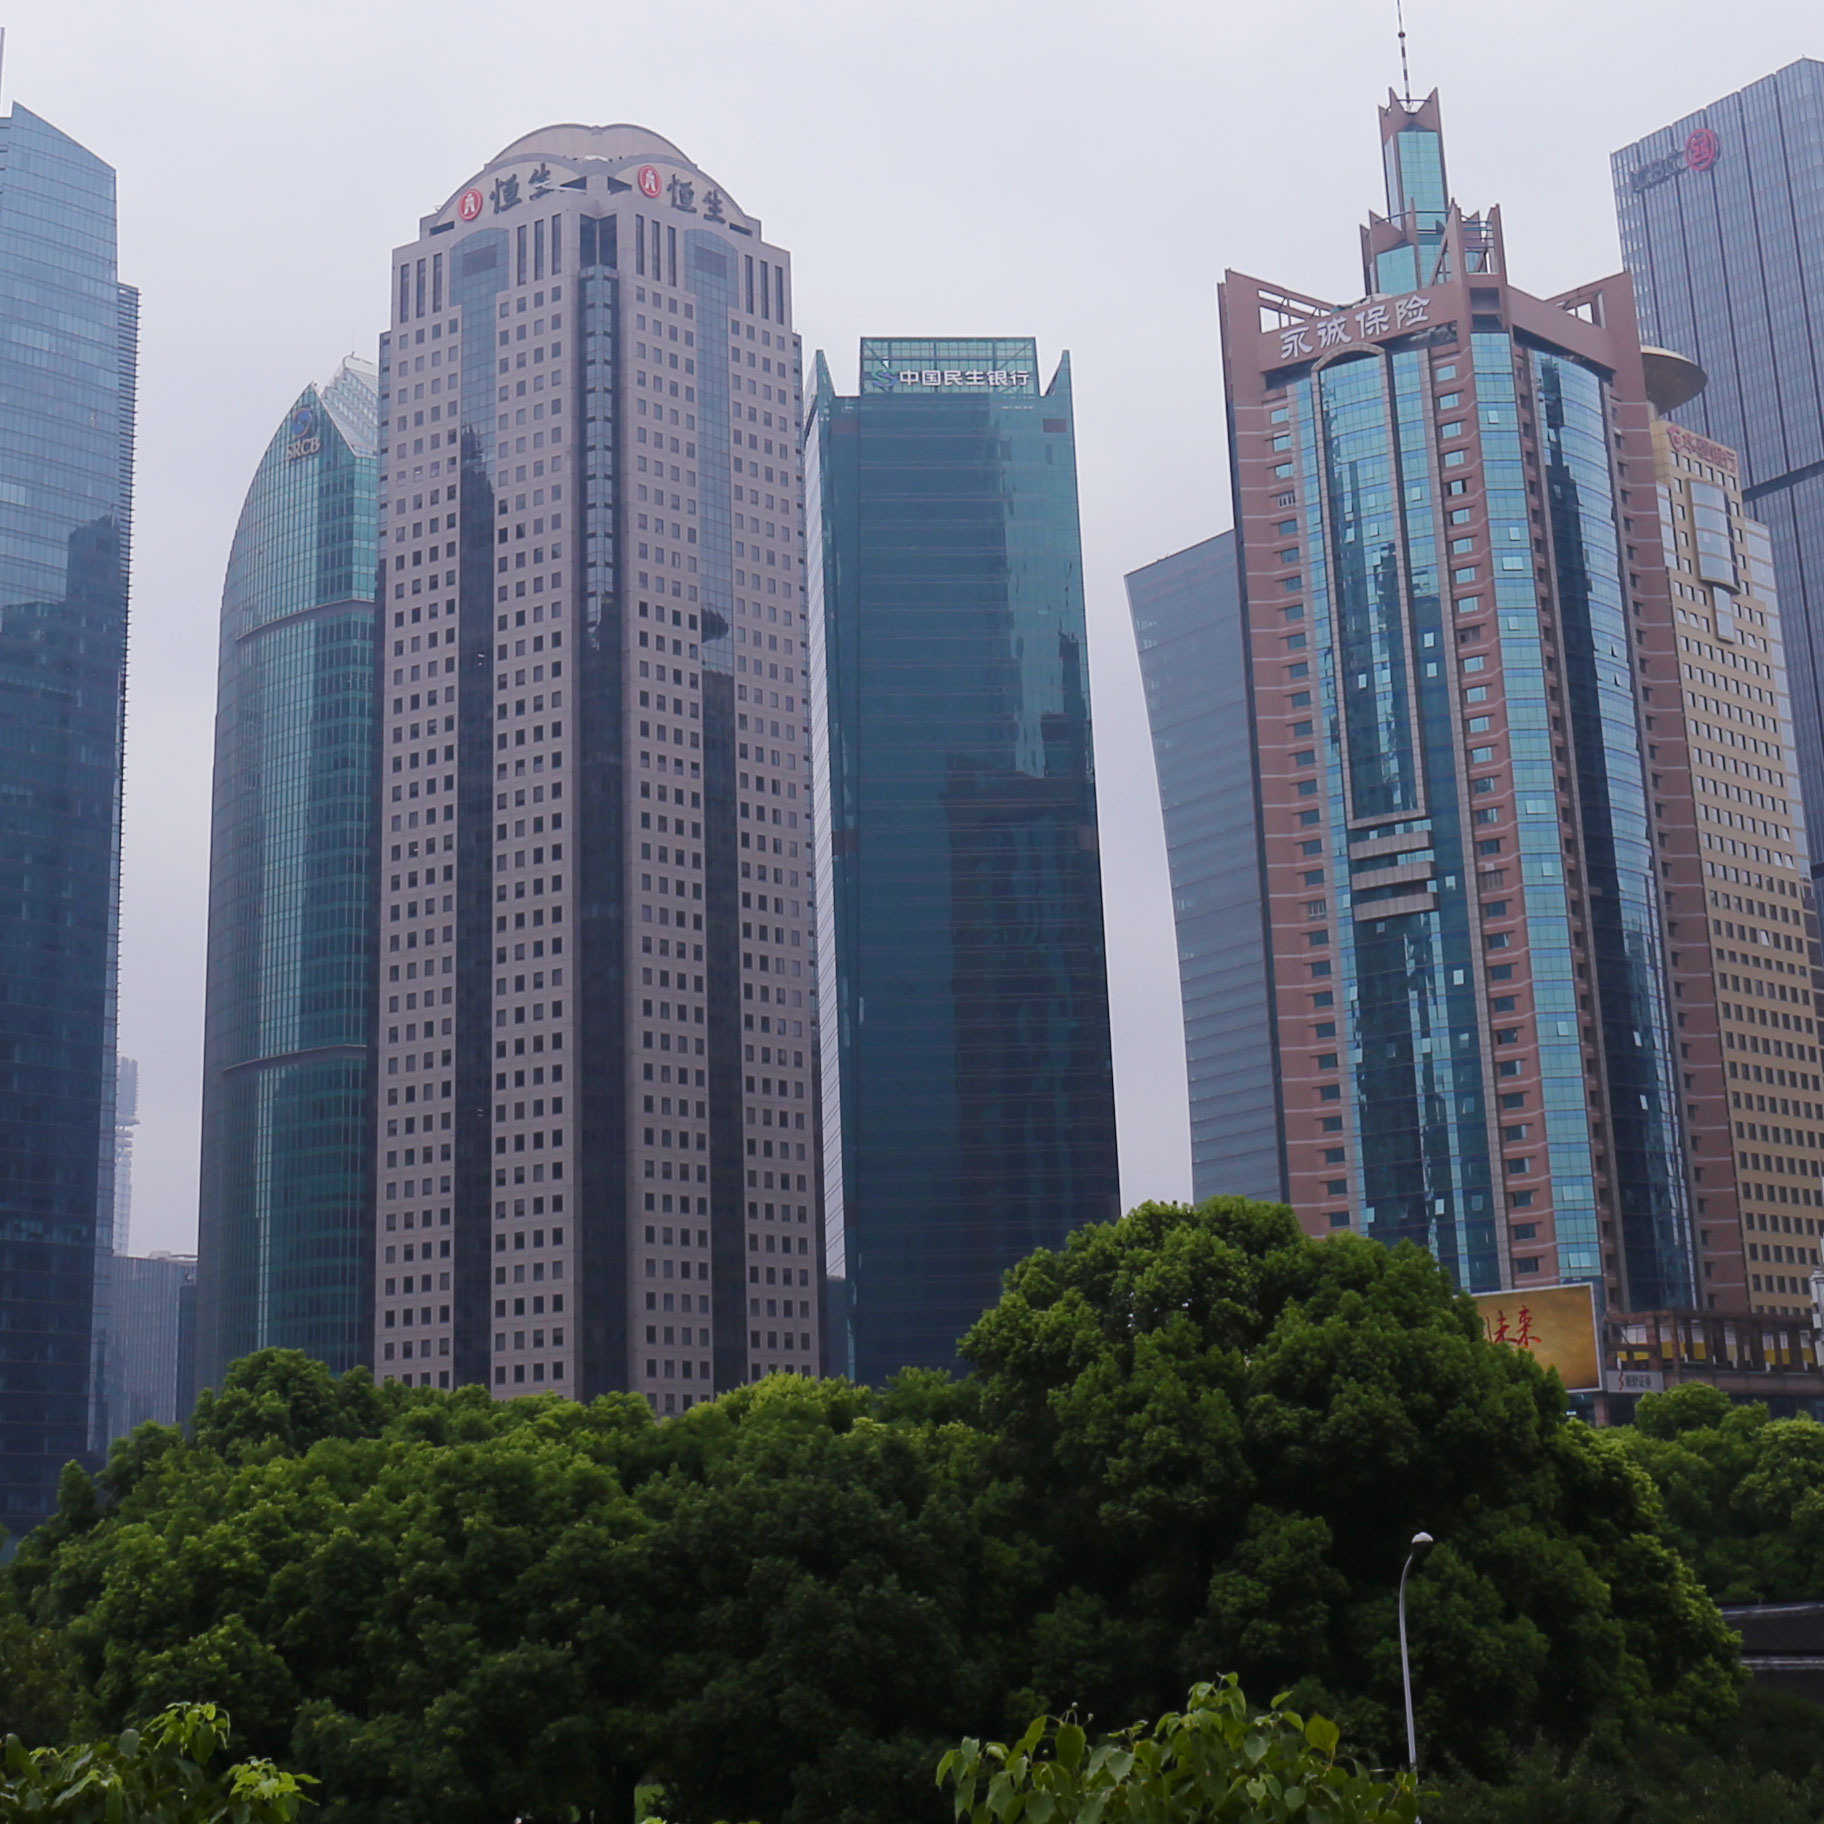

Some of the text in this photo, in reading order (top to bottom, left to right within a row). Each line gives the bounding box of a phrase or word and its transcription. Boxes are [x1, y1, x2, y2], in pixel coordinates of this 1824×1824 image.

[489, 162, 555, 215] 恒生
[666, 172, 727, 225] 恒生
[1280, 294, 1431, 360] 永诚保险
[899, 368, 1030, 387] 中国民生银行
[287, 436, 320, 461] SRCB
